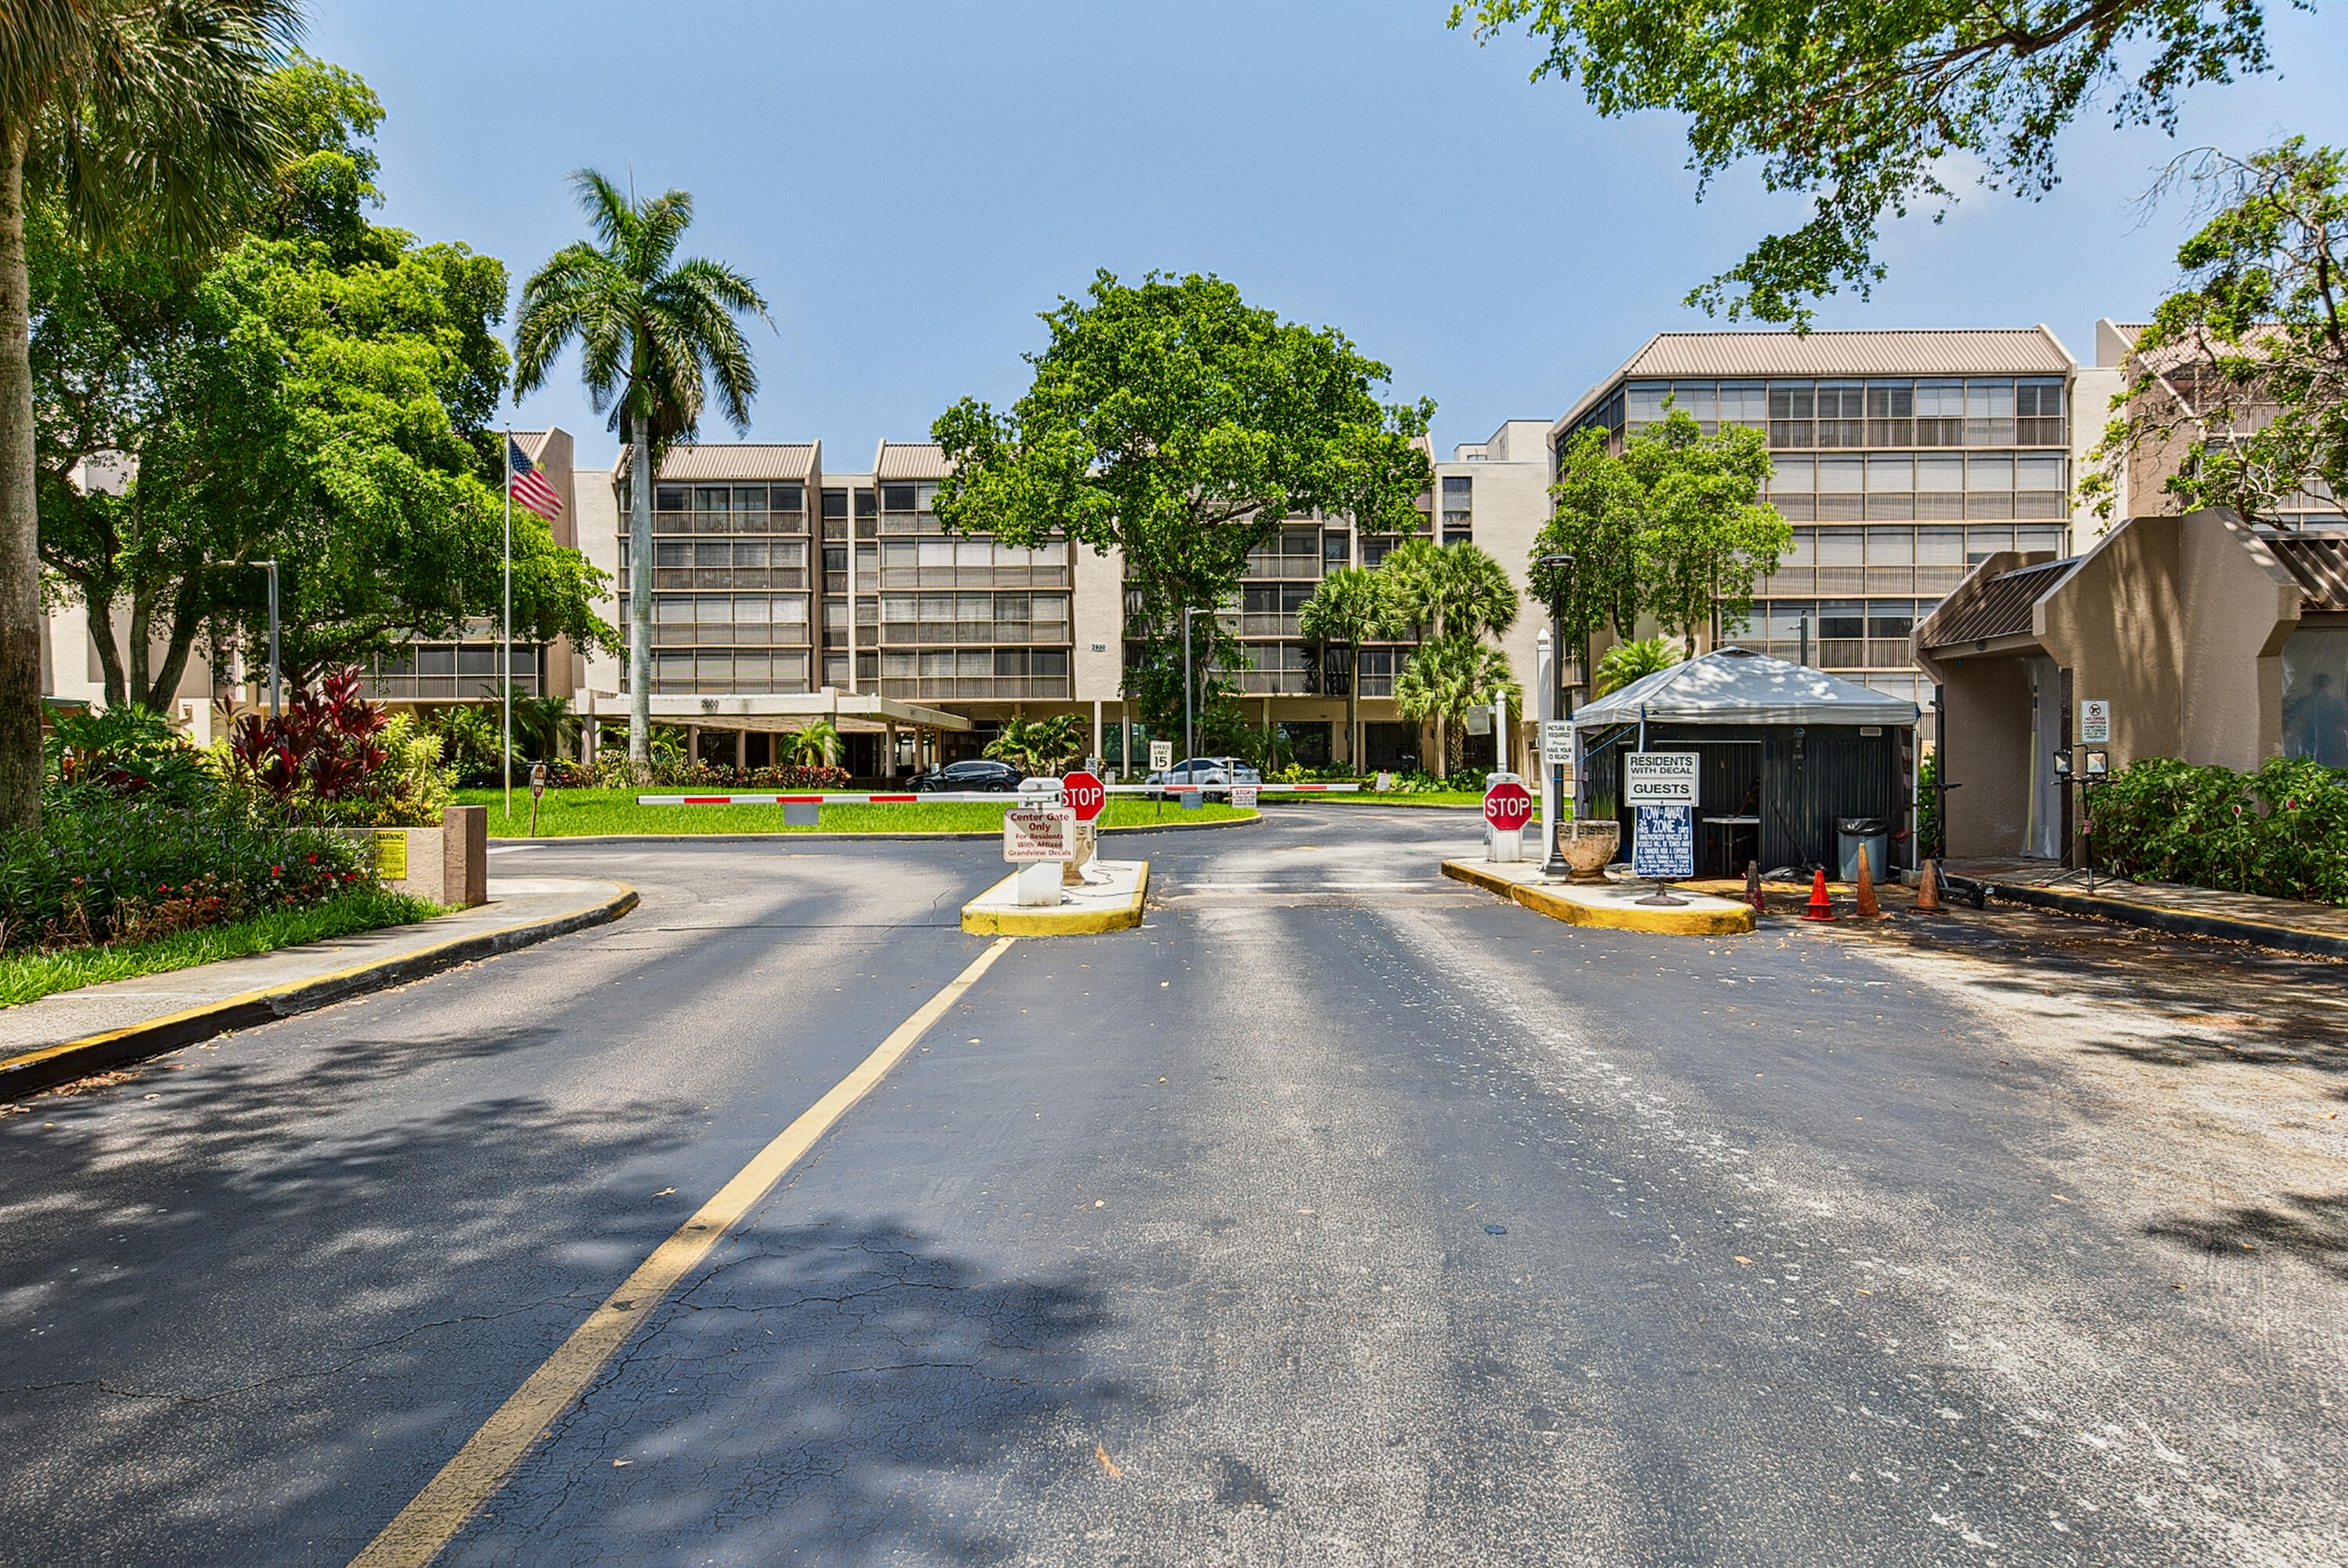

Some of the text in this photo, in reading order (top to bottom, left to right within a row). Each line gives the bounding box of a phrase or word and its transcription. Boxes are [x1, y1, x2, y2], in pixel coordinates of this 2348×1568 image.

[1154, 757, 1168, 768] 15
[1630, 757, 1692, 766] RESIDENTS
[1633, 784, 1689, 793] GUESTS
[1063, 788, 1101, 806] STOP
[1487, 797, 1529, 817] STOP
[1010, 813, 1069, 822] Center Gate
[1028, 822, 1050, 832] Only
[1652, 820, 1675, 833] ZONE
